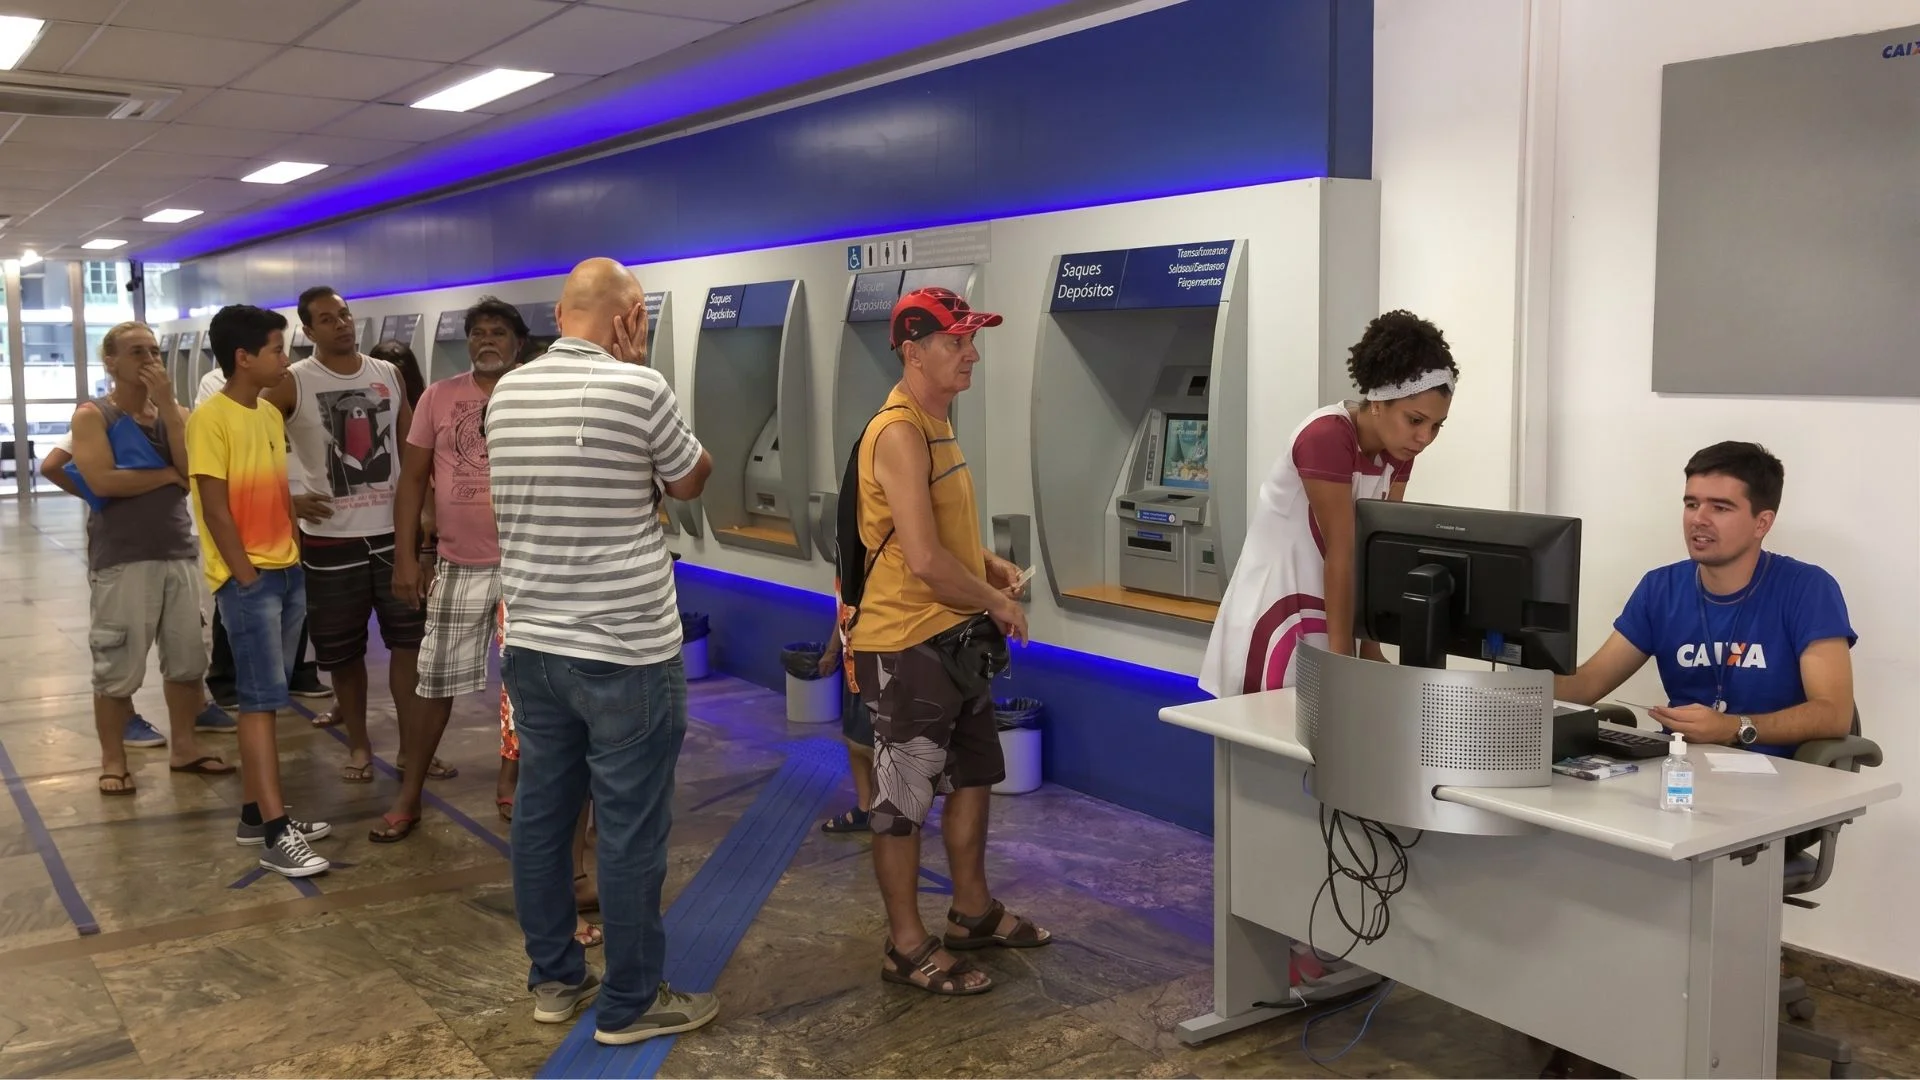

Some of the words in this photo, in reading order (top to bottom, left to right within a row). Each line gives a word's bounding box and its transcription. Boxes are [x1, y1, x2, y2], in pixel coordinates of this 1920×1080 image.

[1062, 262, 1102, 280] Saques
[710, 293, 732, 306] Saques
[1057, 282, 1115, 302] Depósitos
[1676, 641, 1767, 669] CAIXA
